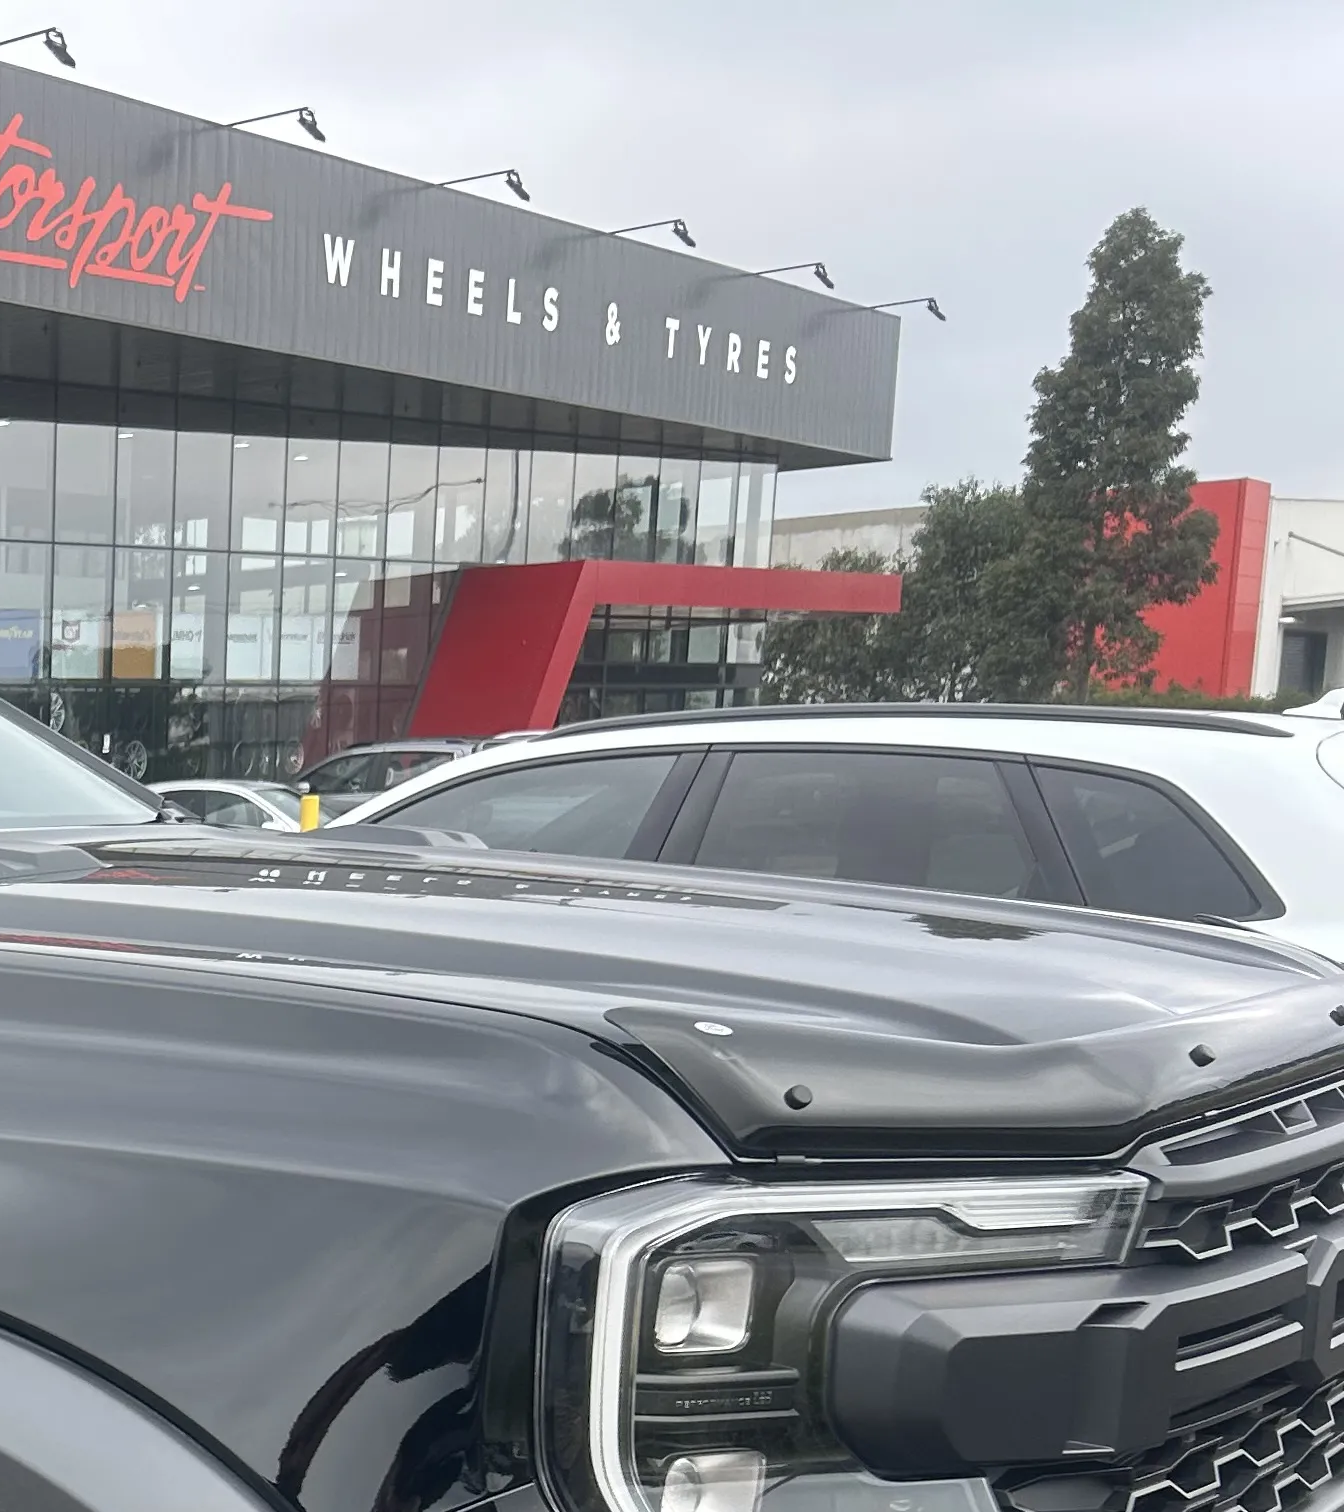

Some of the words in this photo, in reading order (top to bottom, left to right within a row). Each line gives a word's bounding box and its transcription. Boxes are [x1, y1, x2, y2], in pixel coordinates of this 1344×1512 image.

[323, 233, 560, 332] WHEELS
[606, 302, 621, 346] &
[665, 317, 797, 385] TYRES
